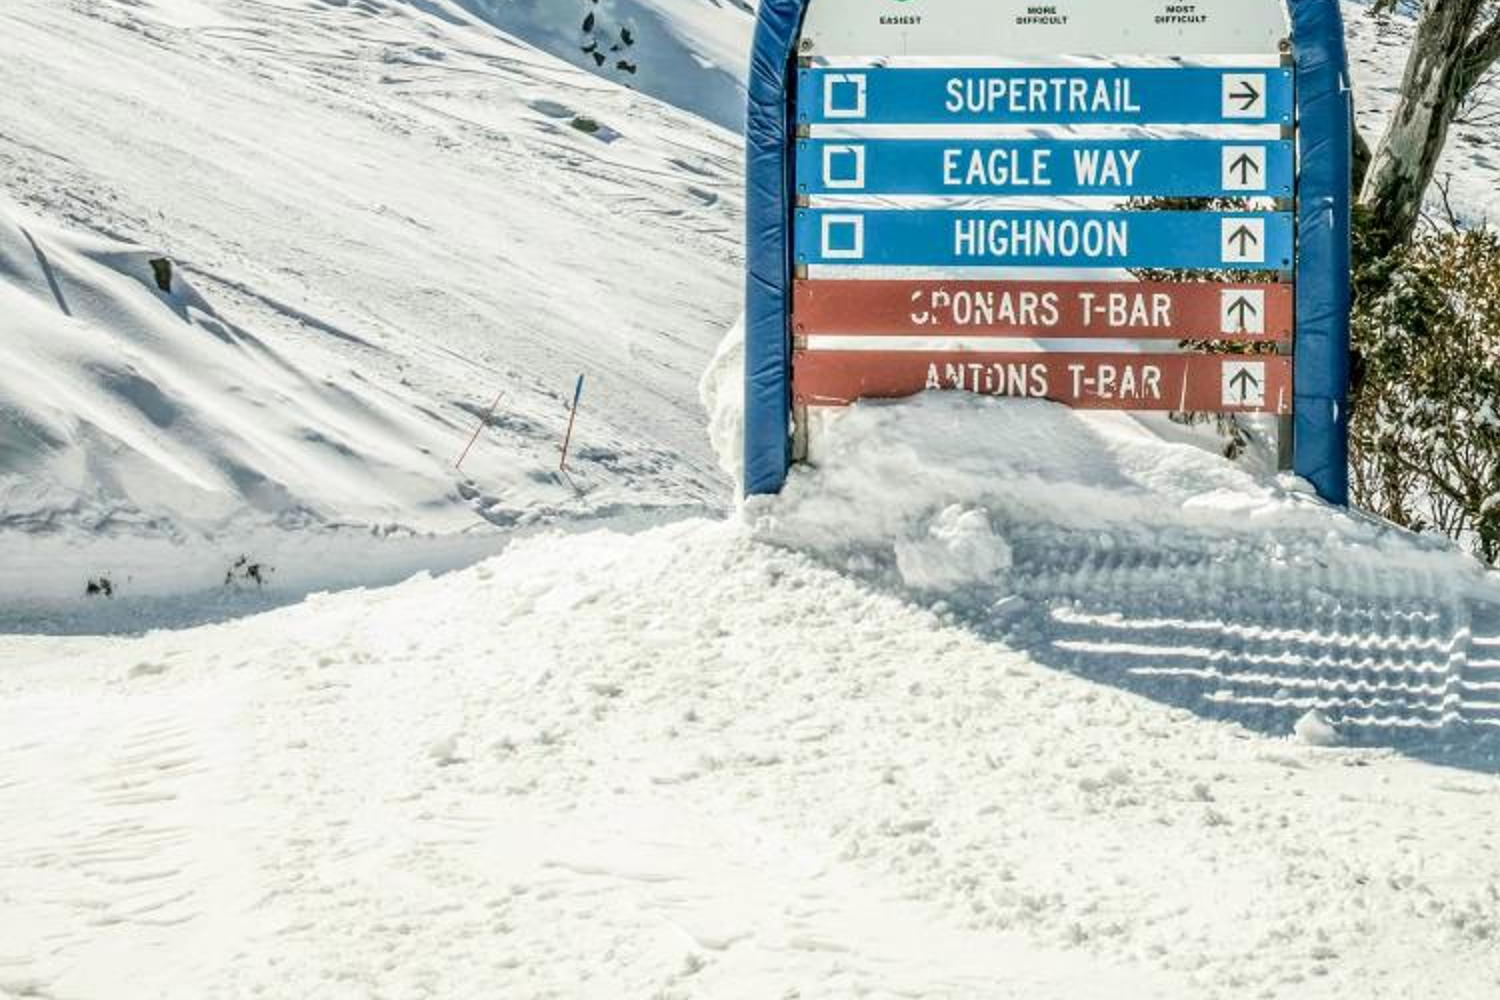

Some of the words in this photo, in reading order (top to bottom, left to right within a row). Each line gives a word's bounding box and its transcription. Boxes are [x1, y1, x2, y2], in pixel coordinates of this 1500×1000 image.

[879, 15, 922, 25] EASIEST
[1016, 15, 1068, 25] DIFFICULT
[1027, 6, 1057, 15] MORE
[1154, 14, 1207, 24] DIFFICULT
[1166, 5, 1196, 14] MOST
[945, 78, 1141, 113] SUPERTRAIL
[943, 149, 1051, 185] EAGLE
[1074, 149, 1141, 186] WAY
[955, 219, 1128, 257] HIGHNOON
[1080, 293, 1172, 328] T-BAR
[1068, 364, 1161, 400] T-BAR
